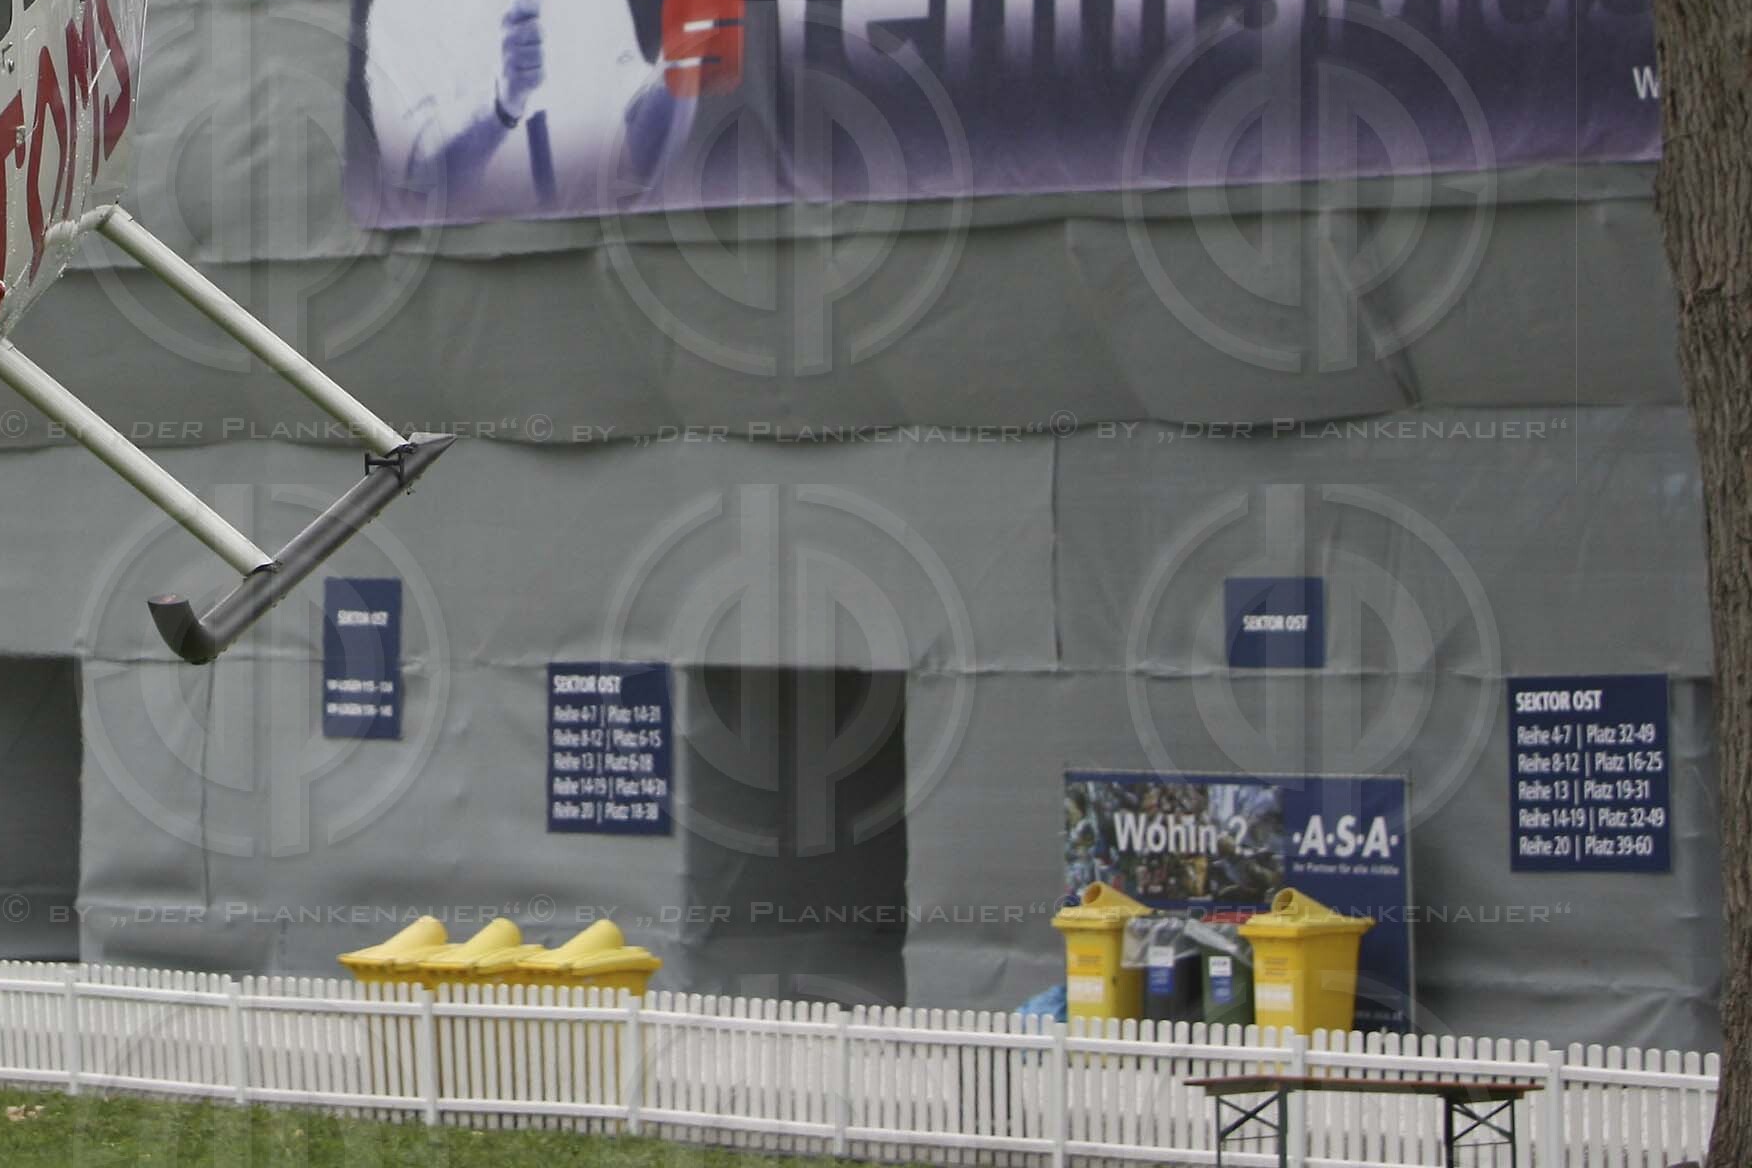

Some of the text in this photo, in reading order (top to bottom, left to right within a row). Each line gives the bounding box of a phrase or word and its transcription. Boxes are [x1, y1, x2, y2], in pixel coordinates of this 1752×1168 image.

[553, 675, 621, 693] SEKTOR OST
[1516, 690, 1602, 713] SEKTOR OST
[1517, 723, 1656, 744] Reihe 4-7 Platz 32-49
[1518, 751, 1663, 772] Reihe 8-12 Platz 16-25
[1518, 779, 1650, 800] Reihe 13 Platz 19-31
[1519, 807, 1665, 827] Reihe 14-19 Platz 32-49
[1113, 812, 1218, 854] Wohin
[1519, 835, 1653, 855] Reihe 20 Platz 39-60
